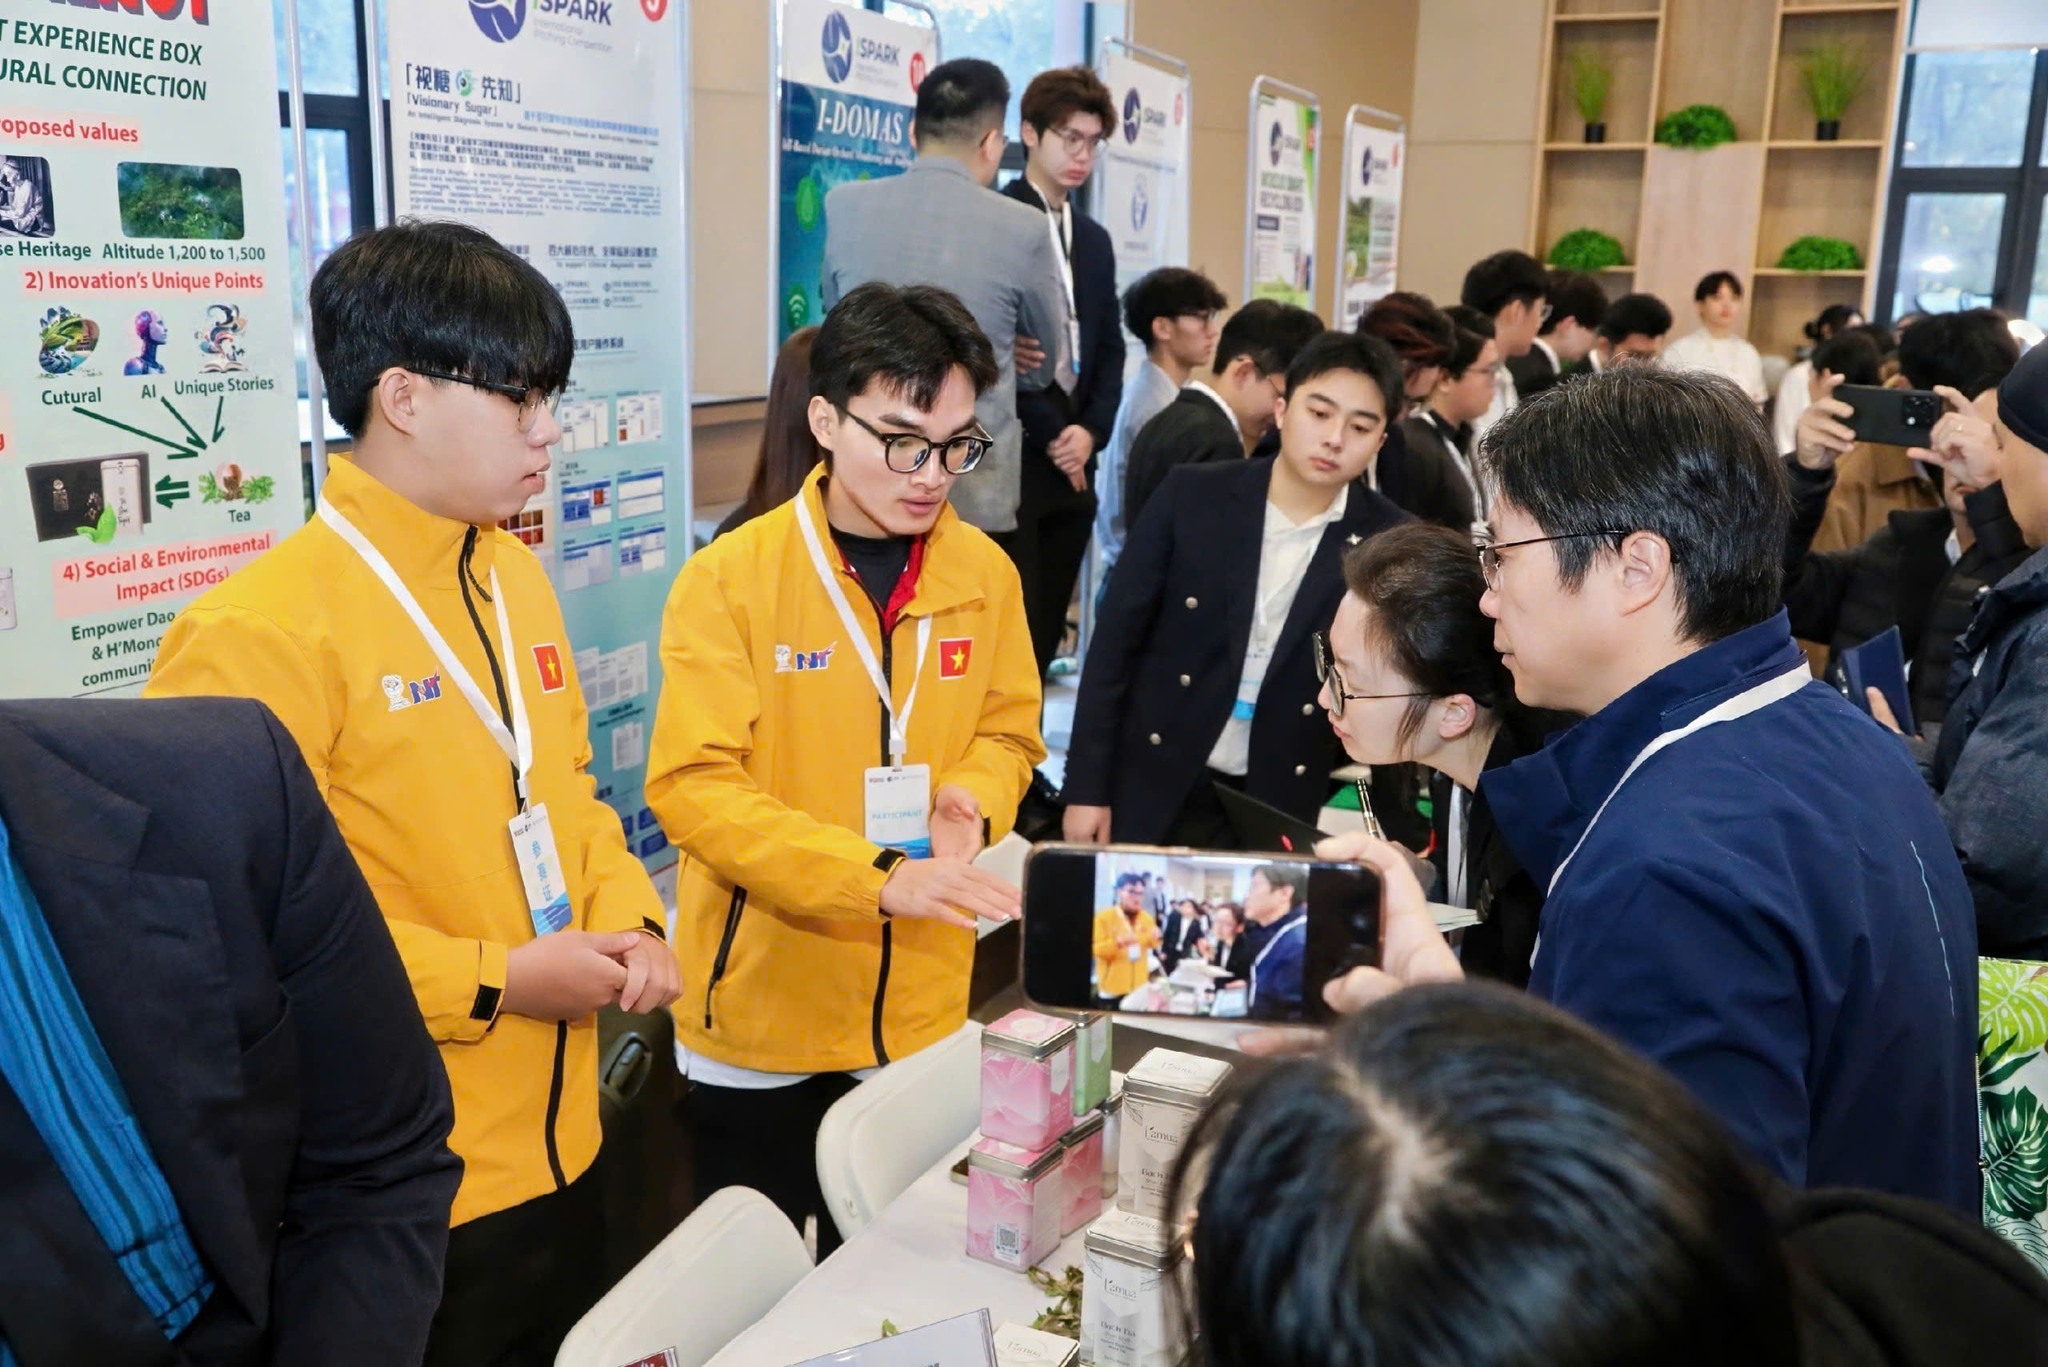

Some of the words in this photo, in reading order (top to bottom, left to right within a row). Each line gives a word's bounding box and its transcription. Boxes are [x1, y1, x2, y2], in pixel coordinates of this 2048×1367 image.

[14, 20, 155, 60] EXPERIENCE
[159, 40, 203, 66] BOX
[62, 65, 207, 101] CONNECTION
[0, 118, 75, 139] oposed
[79, 122, 139, 143] values
[817, 97, 904, 145] I-DOMAS
[18, 241, 92, 261] Heritage
[102, 243, 165, 260] Altitude
[169, 245, 207, 262] 1,200
[210, 247, 224, 260] to
[227, 246, 266, 262] 1,500
[25, 271, 44, 292] 2)
[49, 270, 148, 290] Inovation's
[152, 271, 211, 293] Unique
[215, 272, 264, 290] Points
[41, 387, 102, 406] Cutural
[141, 384, 157, 399] AI
[174, 380, 225, 397] Unique
[227, 378, 275, 392] Stories
[228, 509, 251, 523] Tea
[63, 562, 81, 582] 4)
[85, 554, 136, 579] Social
[140, 552, 154, 569] &
[157, 534, 271, 568] Environmental
[117, 578, 175, 601] Impact
[71, 615, 144, 642] Empower
[147, 611, 176, 627] Dao
[92, 646, 103, 660] &
[82, 659, 155, 687] communi
[871, 809, 923, 820] PARTICIPANT
